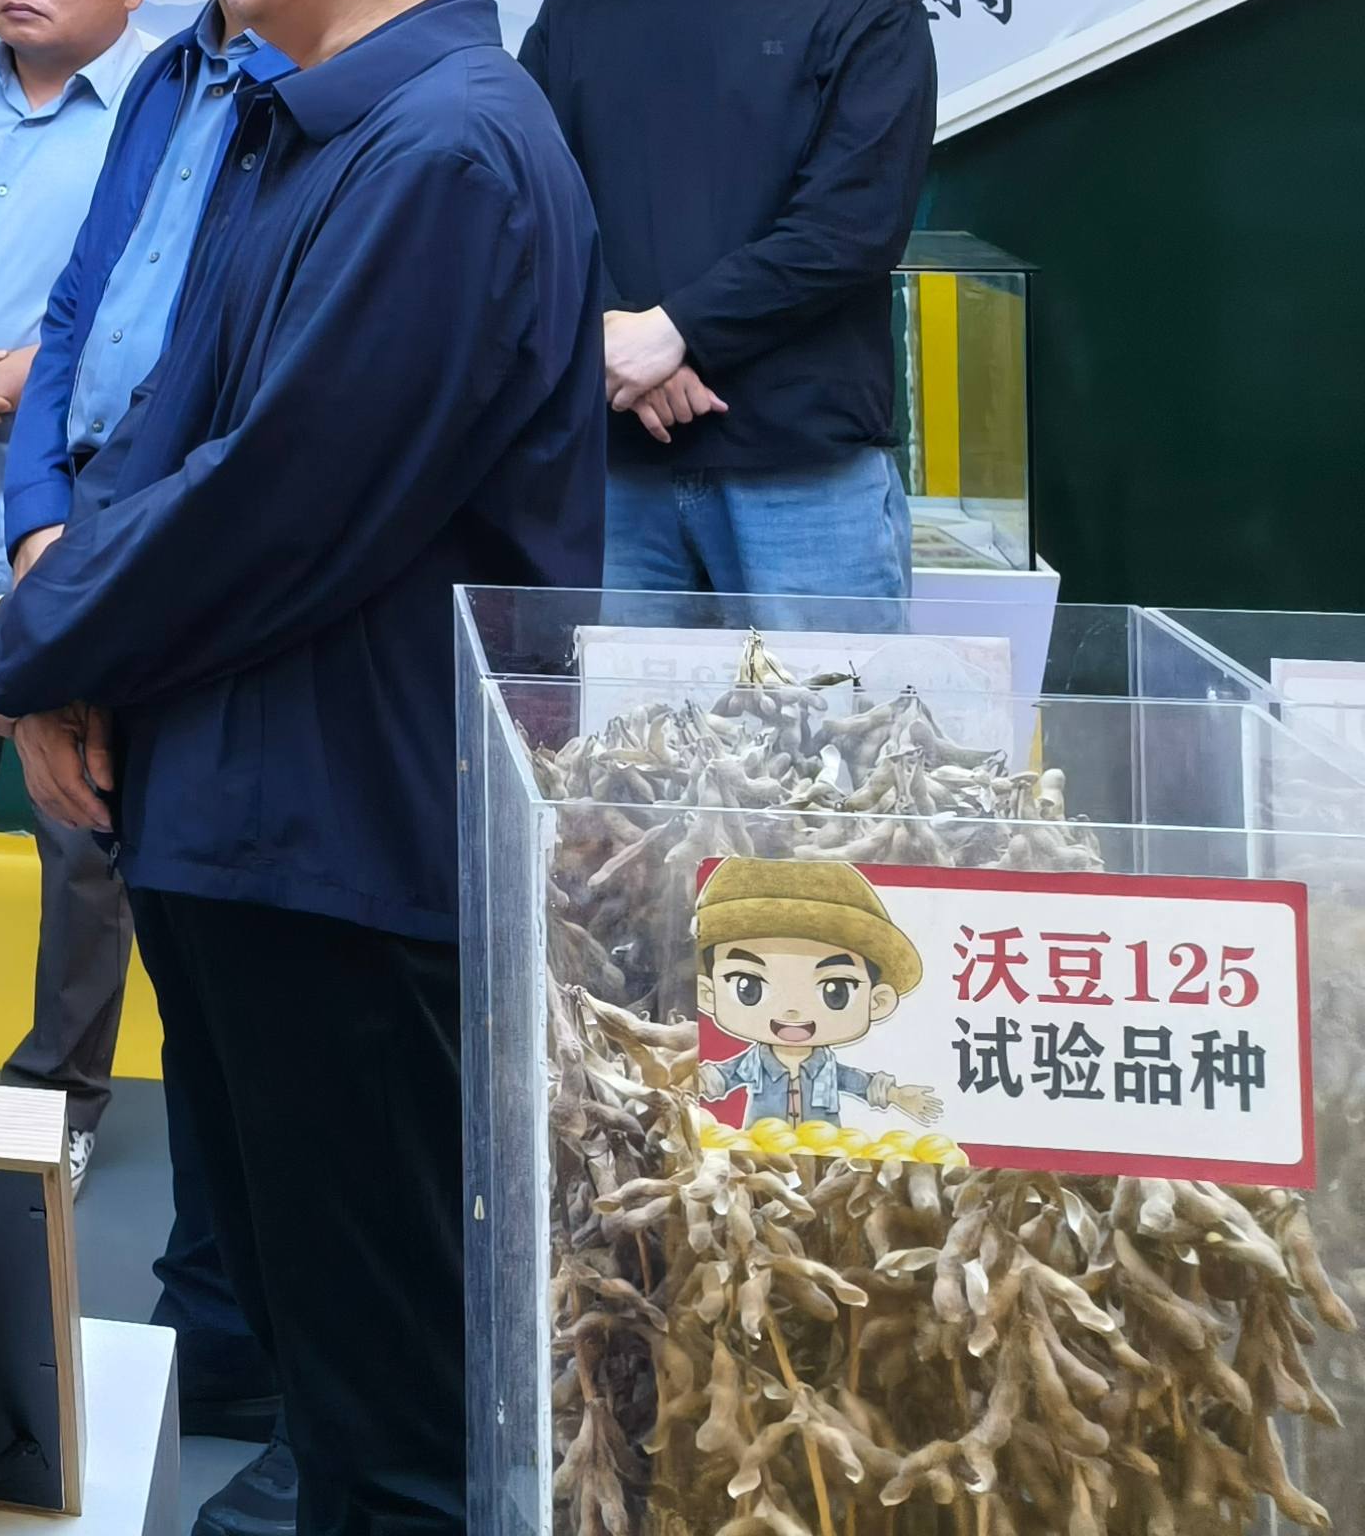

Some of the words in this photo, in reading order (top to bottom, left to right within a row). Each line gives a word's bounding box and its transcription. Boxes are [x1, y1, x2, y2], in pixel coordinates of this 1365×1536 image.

[952, 924, 1260, 1008] 沃豆125
[951, 1016, 1267, 1112] 试验品种
